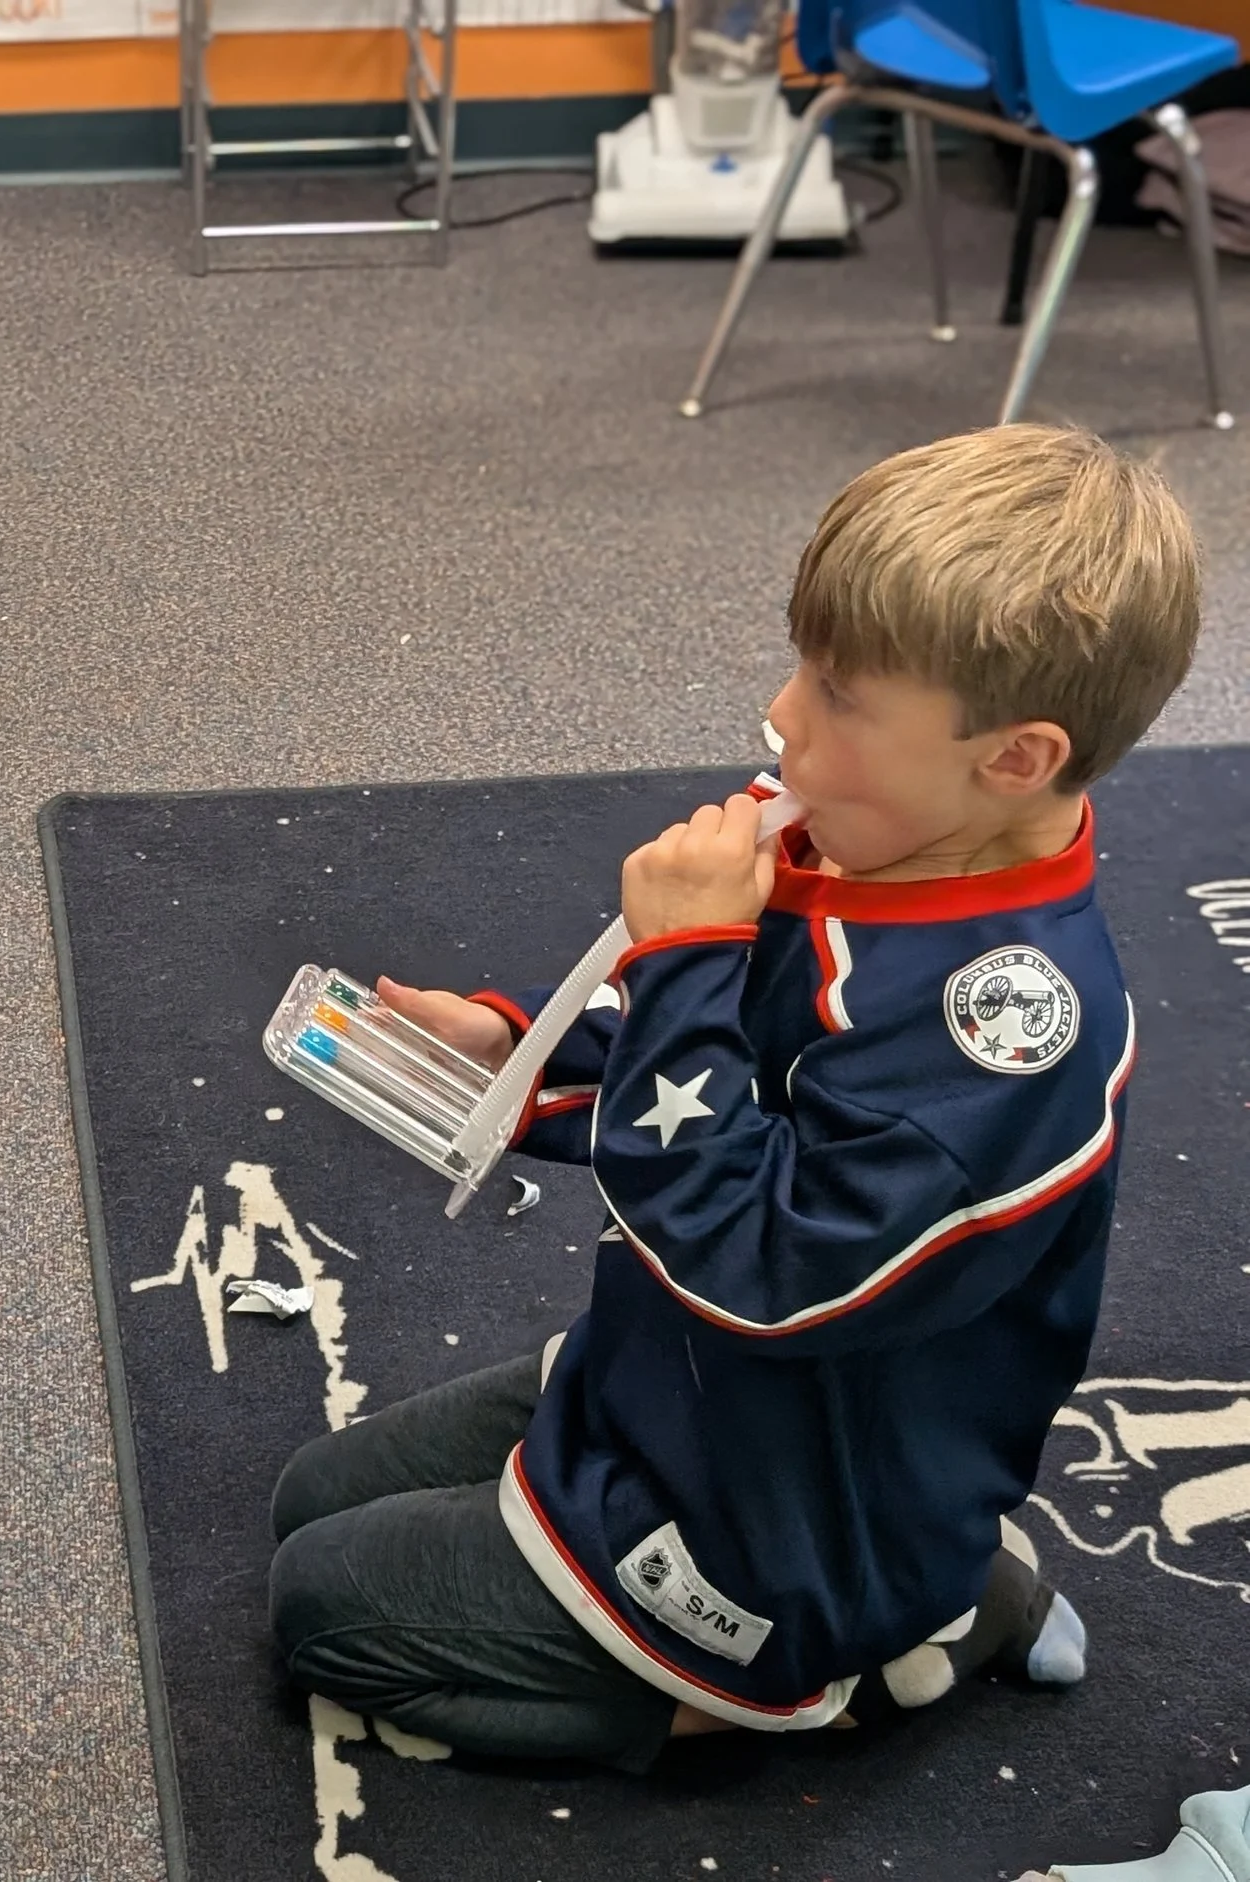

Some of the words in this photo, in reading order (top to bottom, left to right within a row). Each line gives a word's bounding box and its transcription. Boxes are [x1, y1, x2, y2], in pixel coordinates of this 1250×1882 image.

[956, 955, 1015, 1015] COLUMBUS
[1023, 954, 1061, 988] BLUE
[1037, 991, 1071, 1058] JACKETS
[685, 1594, 741, 1639] S/M
